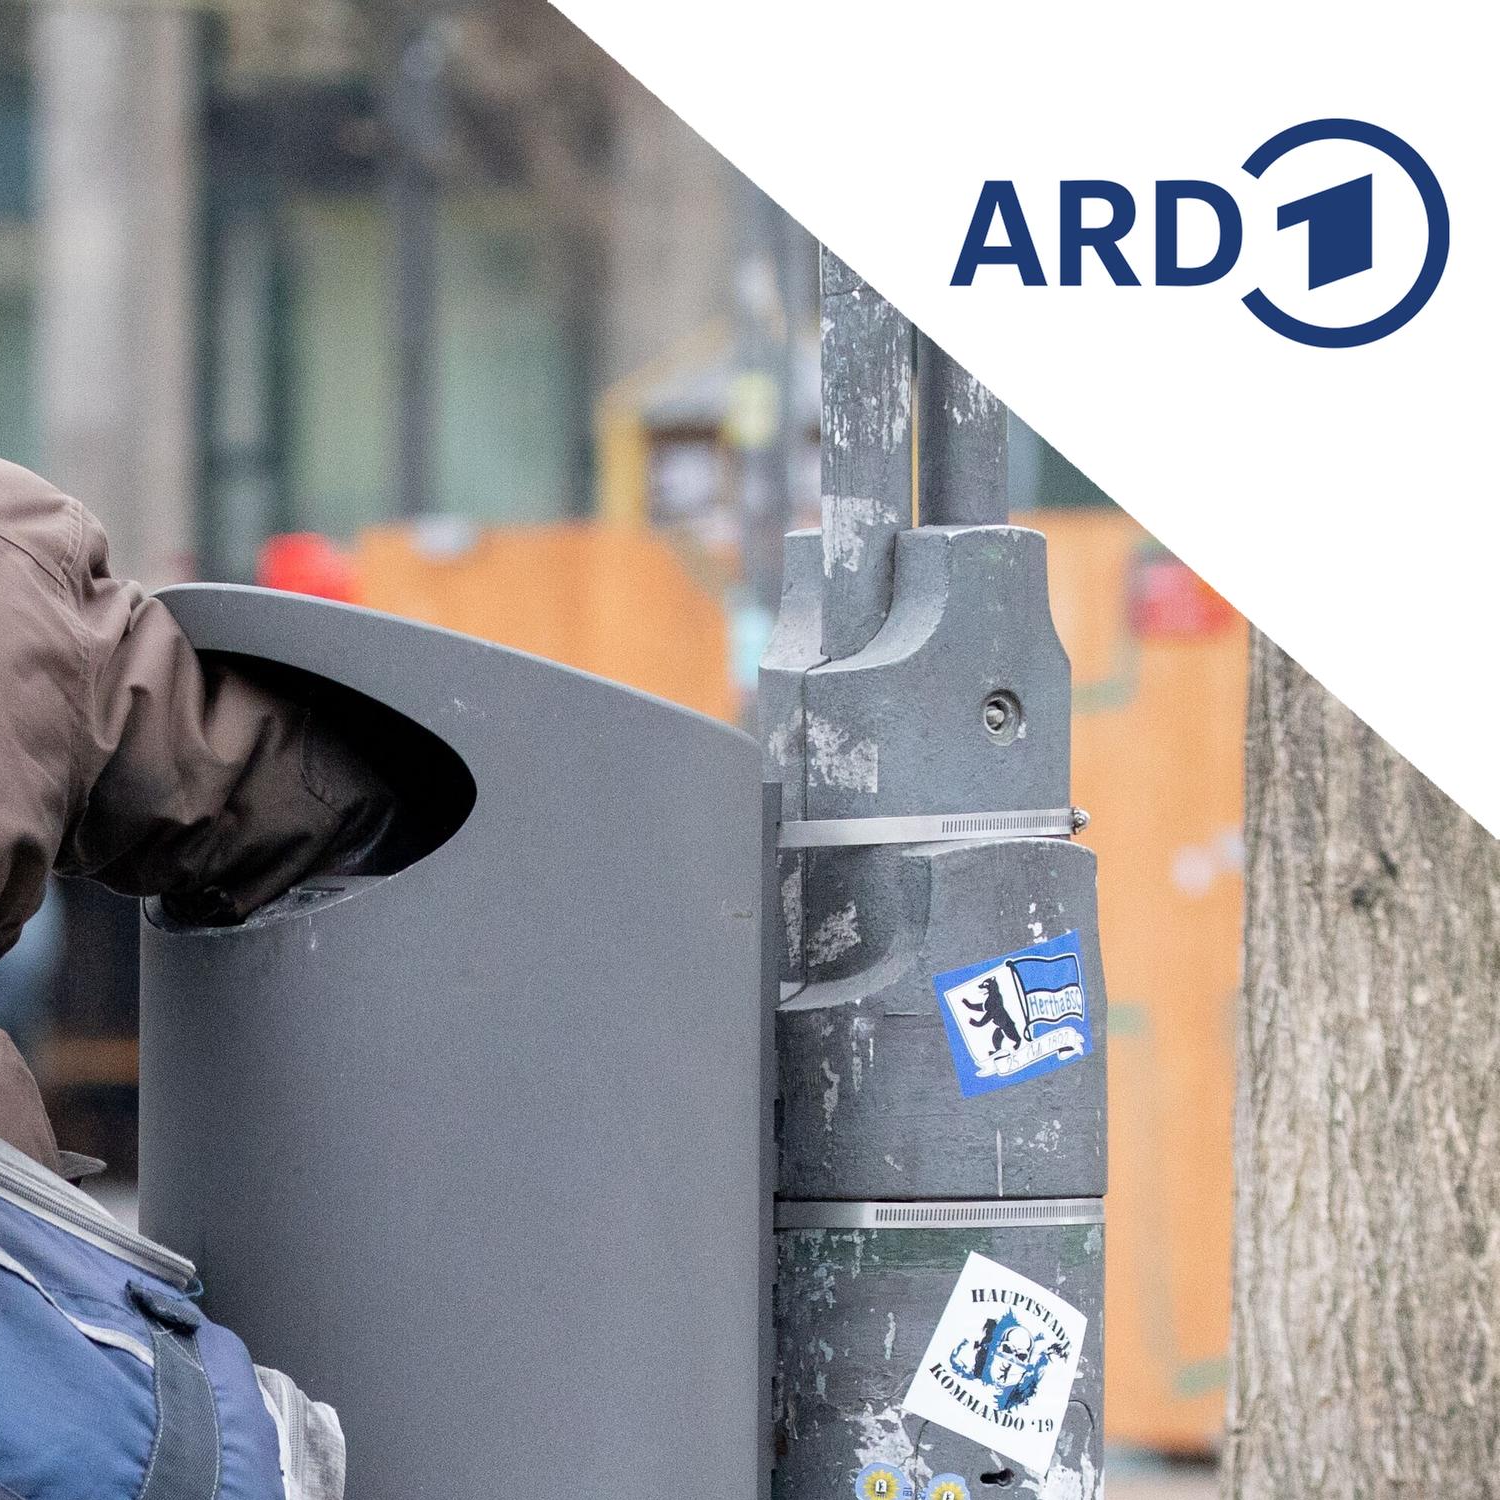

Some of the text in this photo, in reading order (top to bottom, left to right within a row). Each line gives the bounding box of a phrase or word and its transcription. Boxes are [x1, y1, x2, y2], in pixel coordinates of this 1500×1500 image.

[1028, 988, 1082, 1017] Hertha BSC
[970, 1288, 1073, 1351] HAUPTSTADT
[928, 1362, 1025, 1432] KOMMANDO
